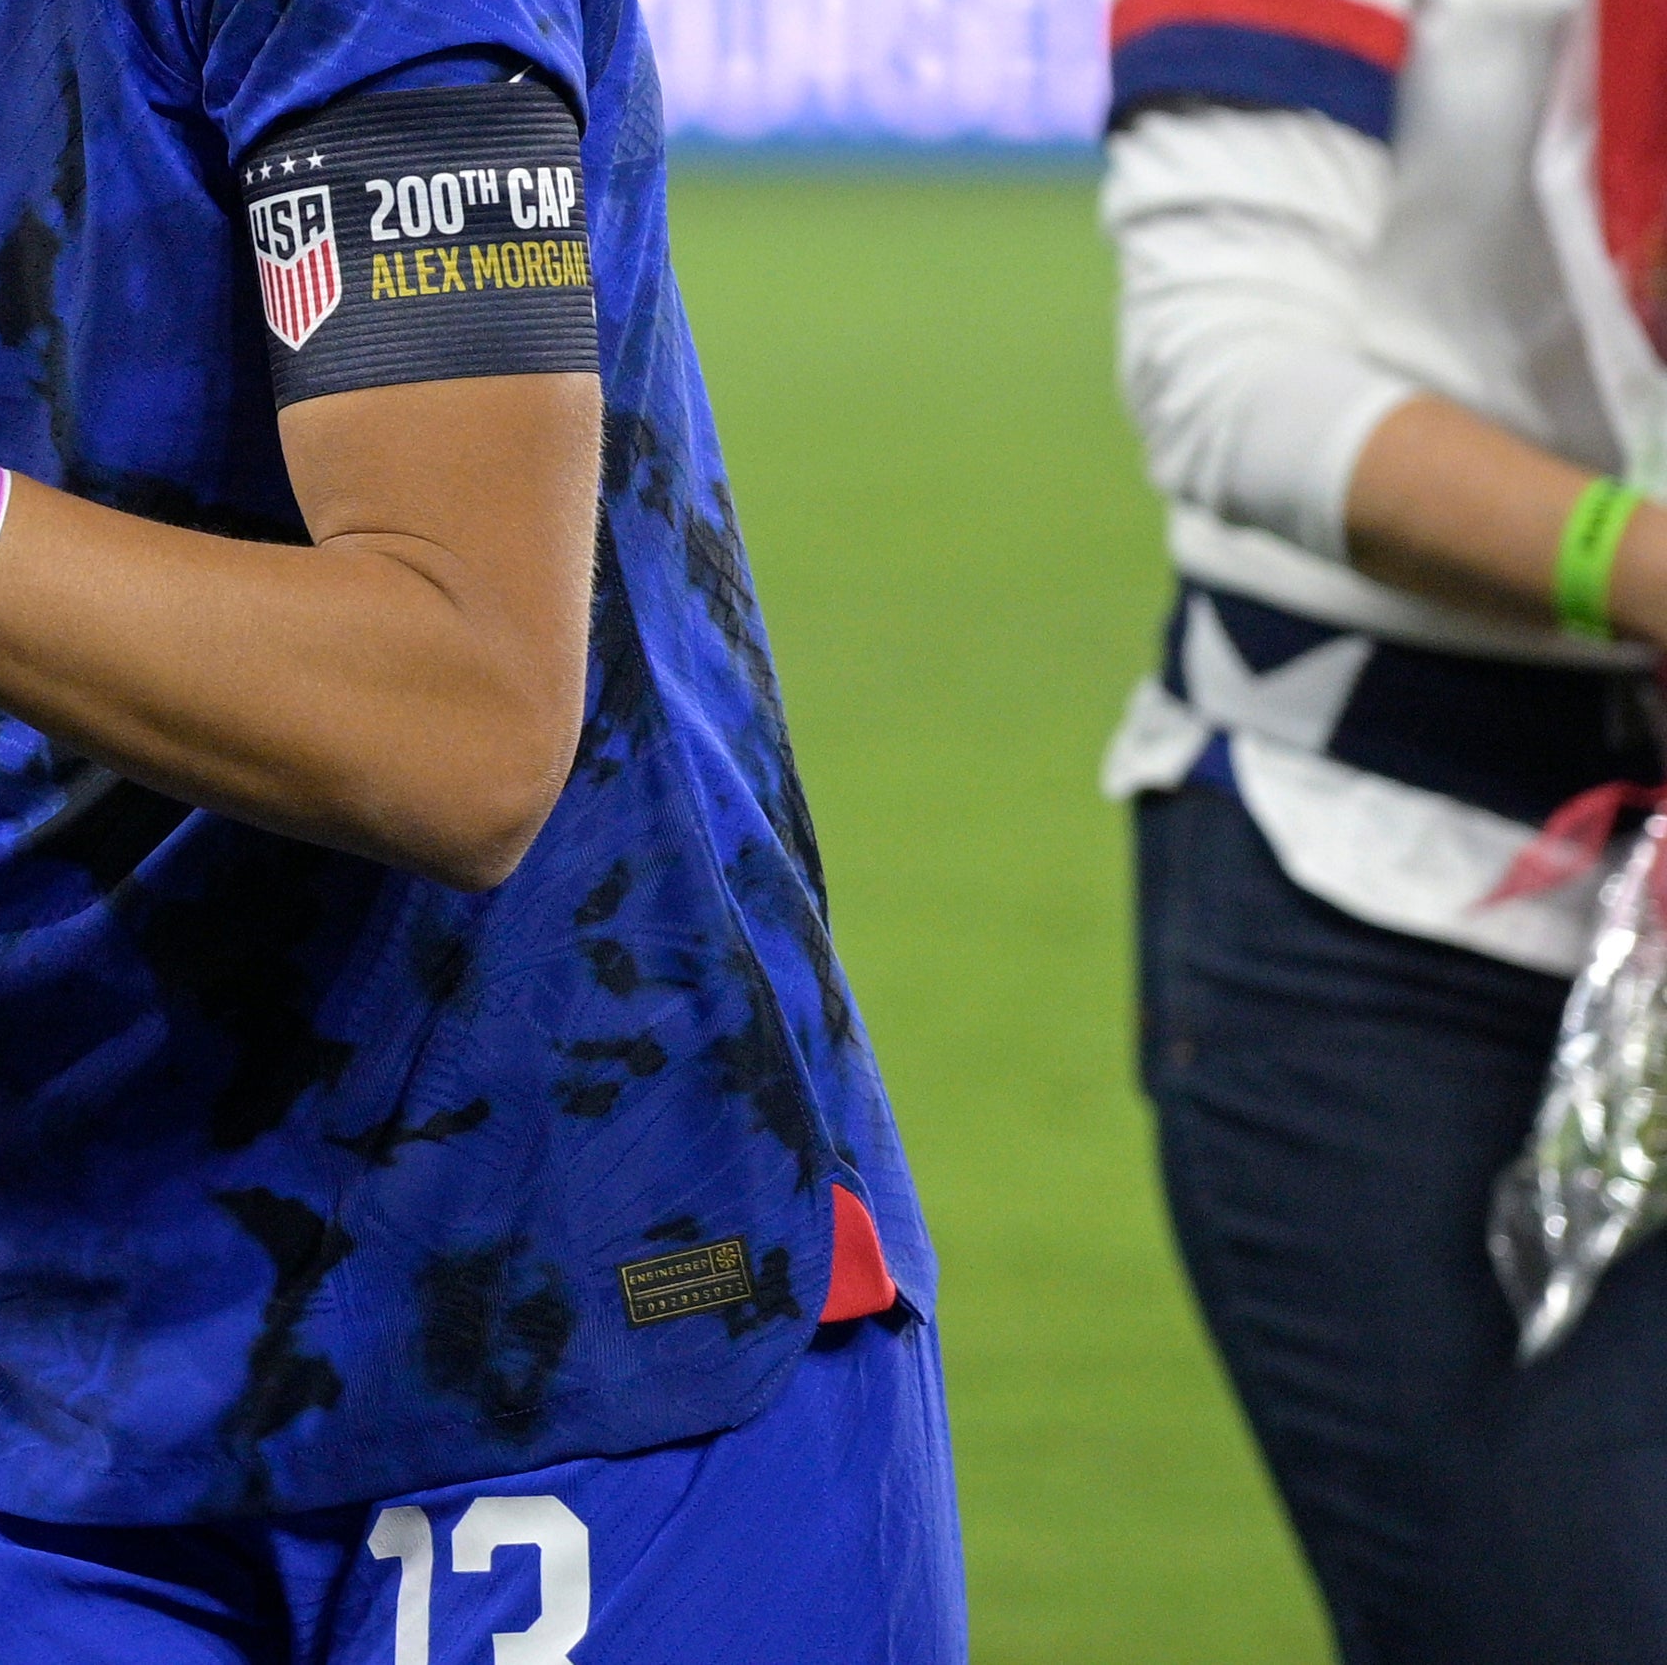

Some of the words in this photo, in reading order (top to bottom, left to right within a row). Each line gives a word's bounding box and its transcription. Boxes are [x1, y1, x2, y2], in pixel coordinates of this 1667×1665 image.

[251, 193, 327, 261] USA
[365, 172, 500, 242] 200TH
[507, 167, 576, 230] CAP
[372, 245, 467, 301] ALEX
[469, 239, 588, 291] MORGAN
[367, 1494, 591, 1665] 13
